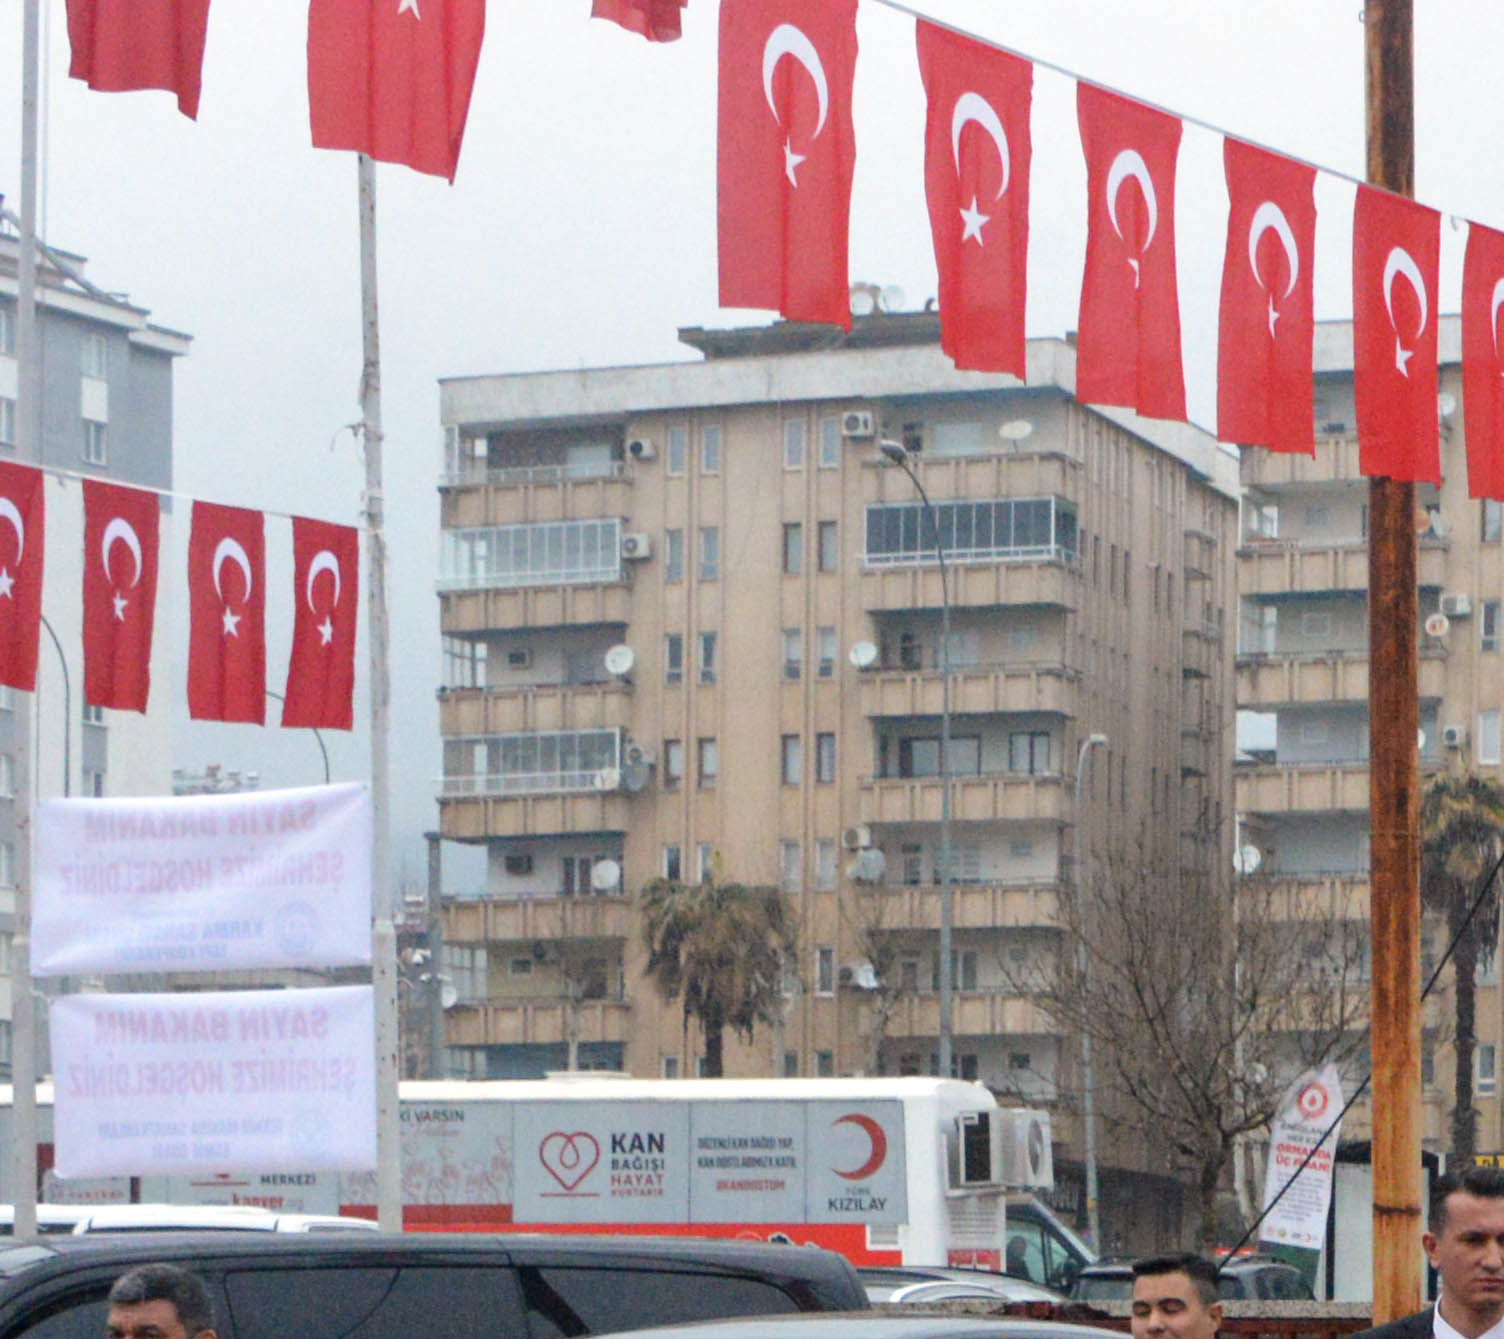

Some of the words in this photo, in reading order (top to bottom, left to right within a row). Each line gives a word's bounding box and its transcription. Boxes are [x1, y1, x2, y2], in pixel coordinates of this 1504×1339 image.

[611, 1132, 665, 1154] KAN
[611, 1155, 665, 1172] BAĞIŞI
[611, 1173, 665, 1186] HAYAT
[828, 1197, 887, 1212] KIZILAY
